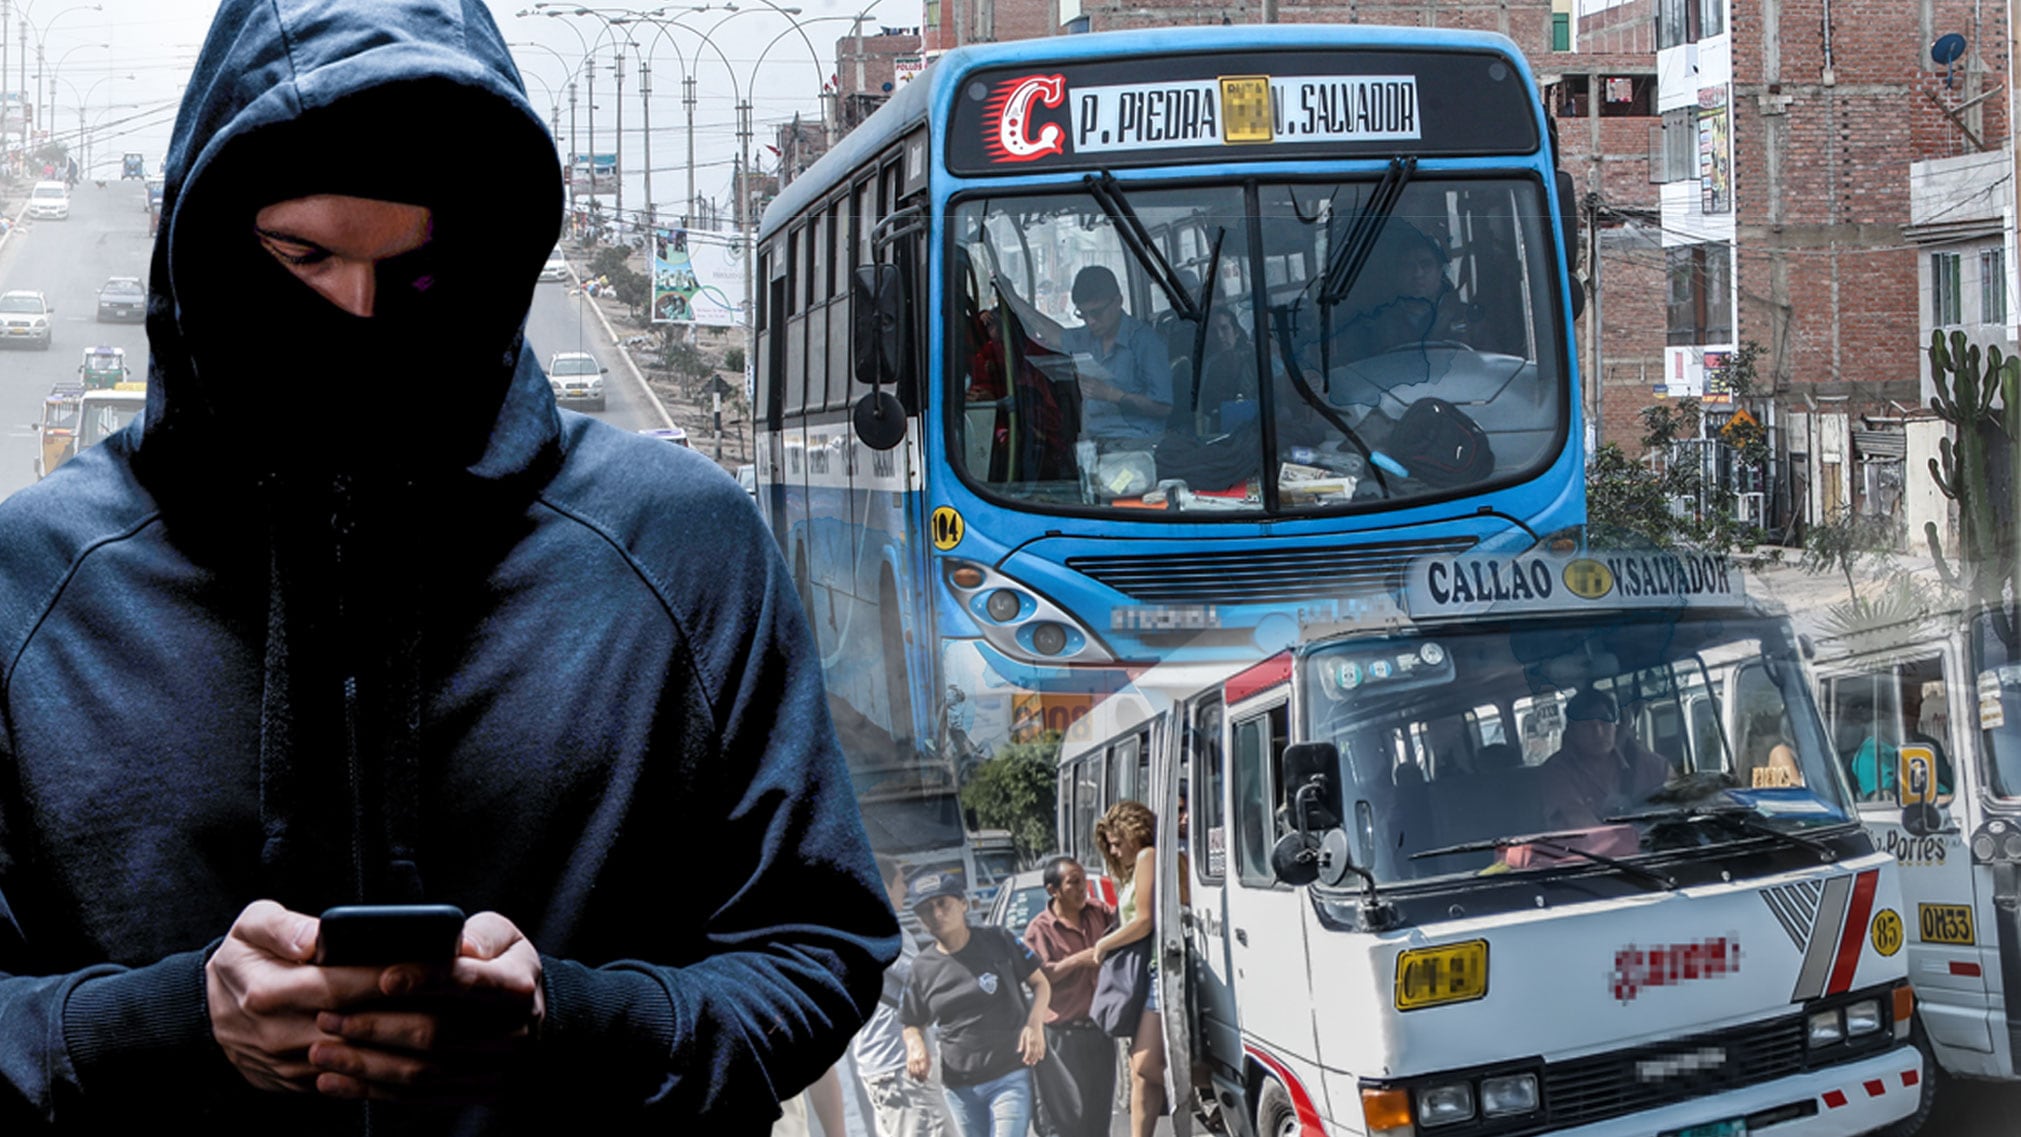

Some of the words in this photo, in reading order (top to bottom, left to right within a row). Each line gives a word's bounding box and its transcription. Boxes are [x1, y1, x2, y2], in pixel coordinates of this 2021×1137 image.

[1080, 95, 1110, 145] P.
[1118, 88, 1217, 143] PIEDRA
[1302, 82, 1414, 134] SALVADOR
[932, 512, 958, 543] 104
[1428, 558, 1553, 605] CALLAO
[1876, 916, 1898, 948] 85
